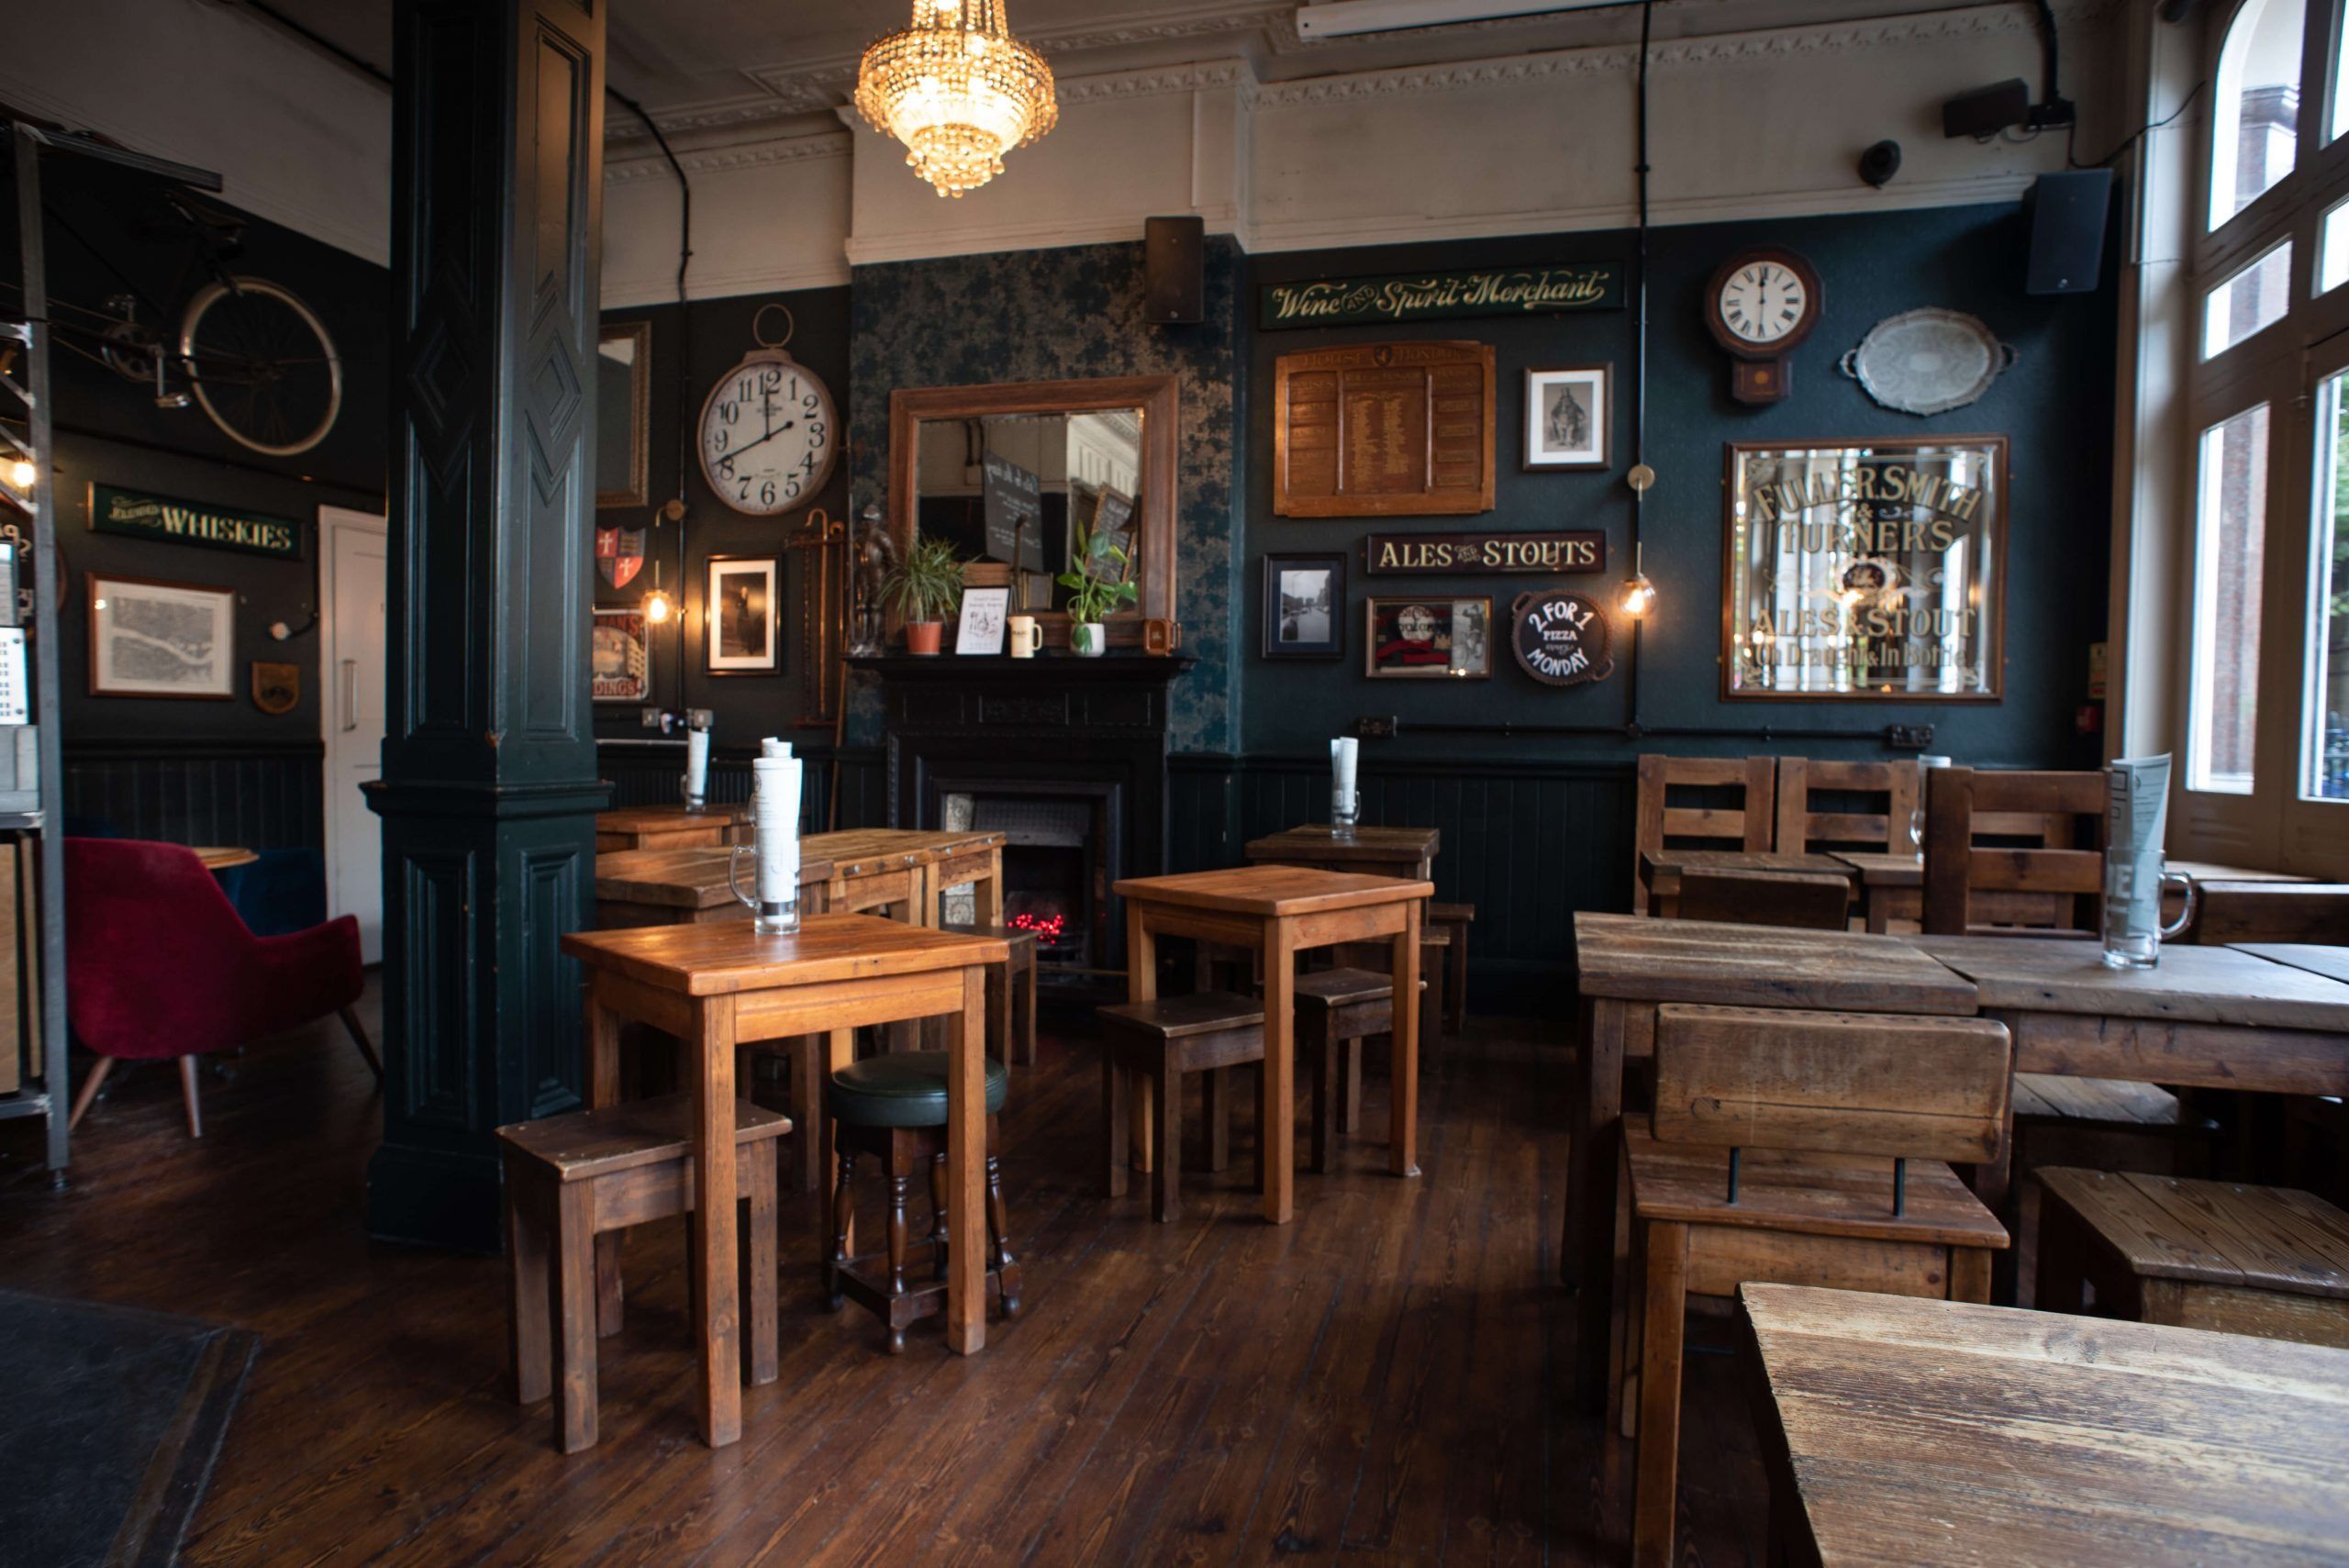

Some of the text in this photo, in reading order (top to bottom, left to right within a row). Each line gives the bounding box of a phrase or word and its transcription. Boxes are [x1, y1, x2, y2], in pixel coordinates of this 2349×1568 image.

[1272, 271, 1609, 318] Wine AND Spirit Merchant
[739, 380, 752, 403] 11
[759, 370, 781, 395] 12
[790, 377, 797, 401] 1
[719, 401, 739, 425] 10
[803, 395, 818, 418] 2
[715, 428, 728, 452] 9
[808, 423, 825, 448] 3
[719, 458, 734, 481] 8
[799, 450, 818, 475] 4
[738, 476, 752, 500] 7
[761, 481, 775, 506] 6
[785, 473, 800, 497] 5
[1858, 503, 1874, 520] &
[162, 506, 292, 550] WHISKIES
[1379, 542, 1453, 567] ALES
[1483, 539, 1596, 567] STOUTS
[1529, 601, 1595, 633] 2 FOR 1
[1753, 608, 1841, 637] ALES
[1866, 607, 1976, 638] STOUT
[1542, 630, 1578, 640] PIZZA
[1527, 648, 1589, 676] MONDAY
